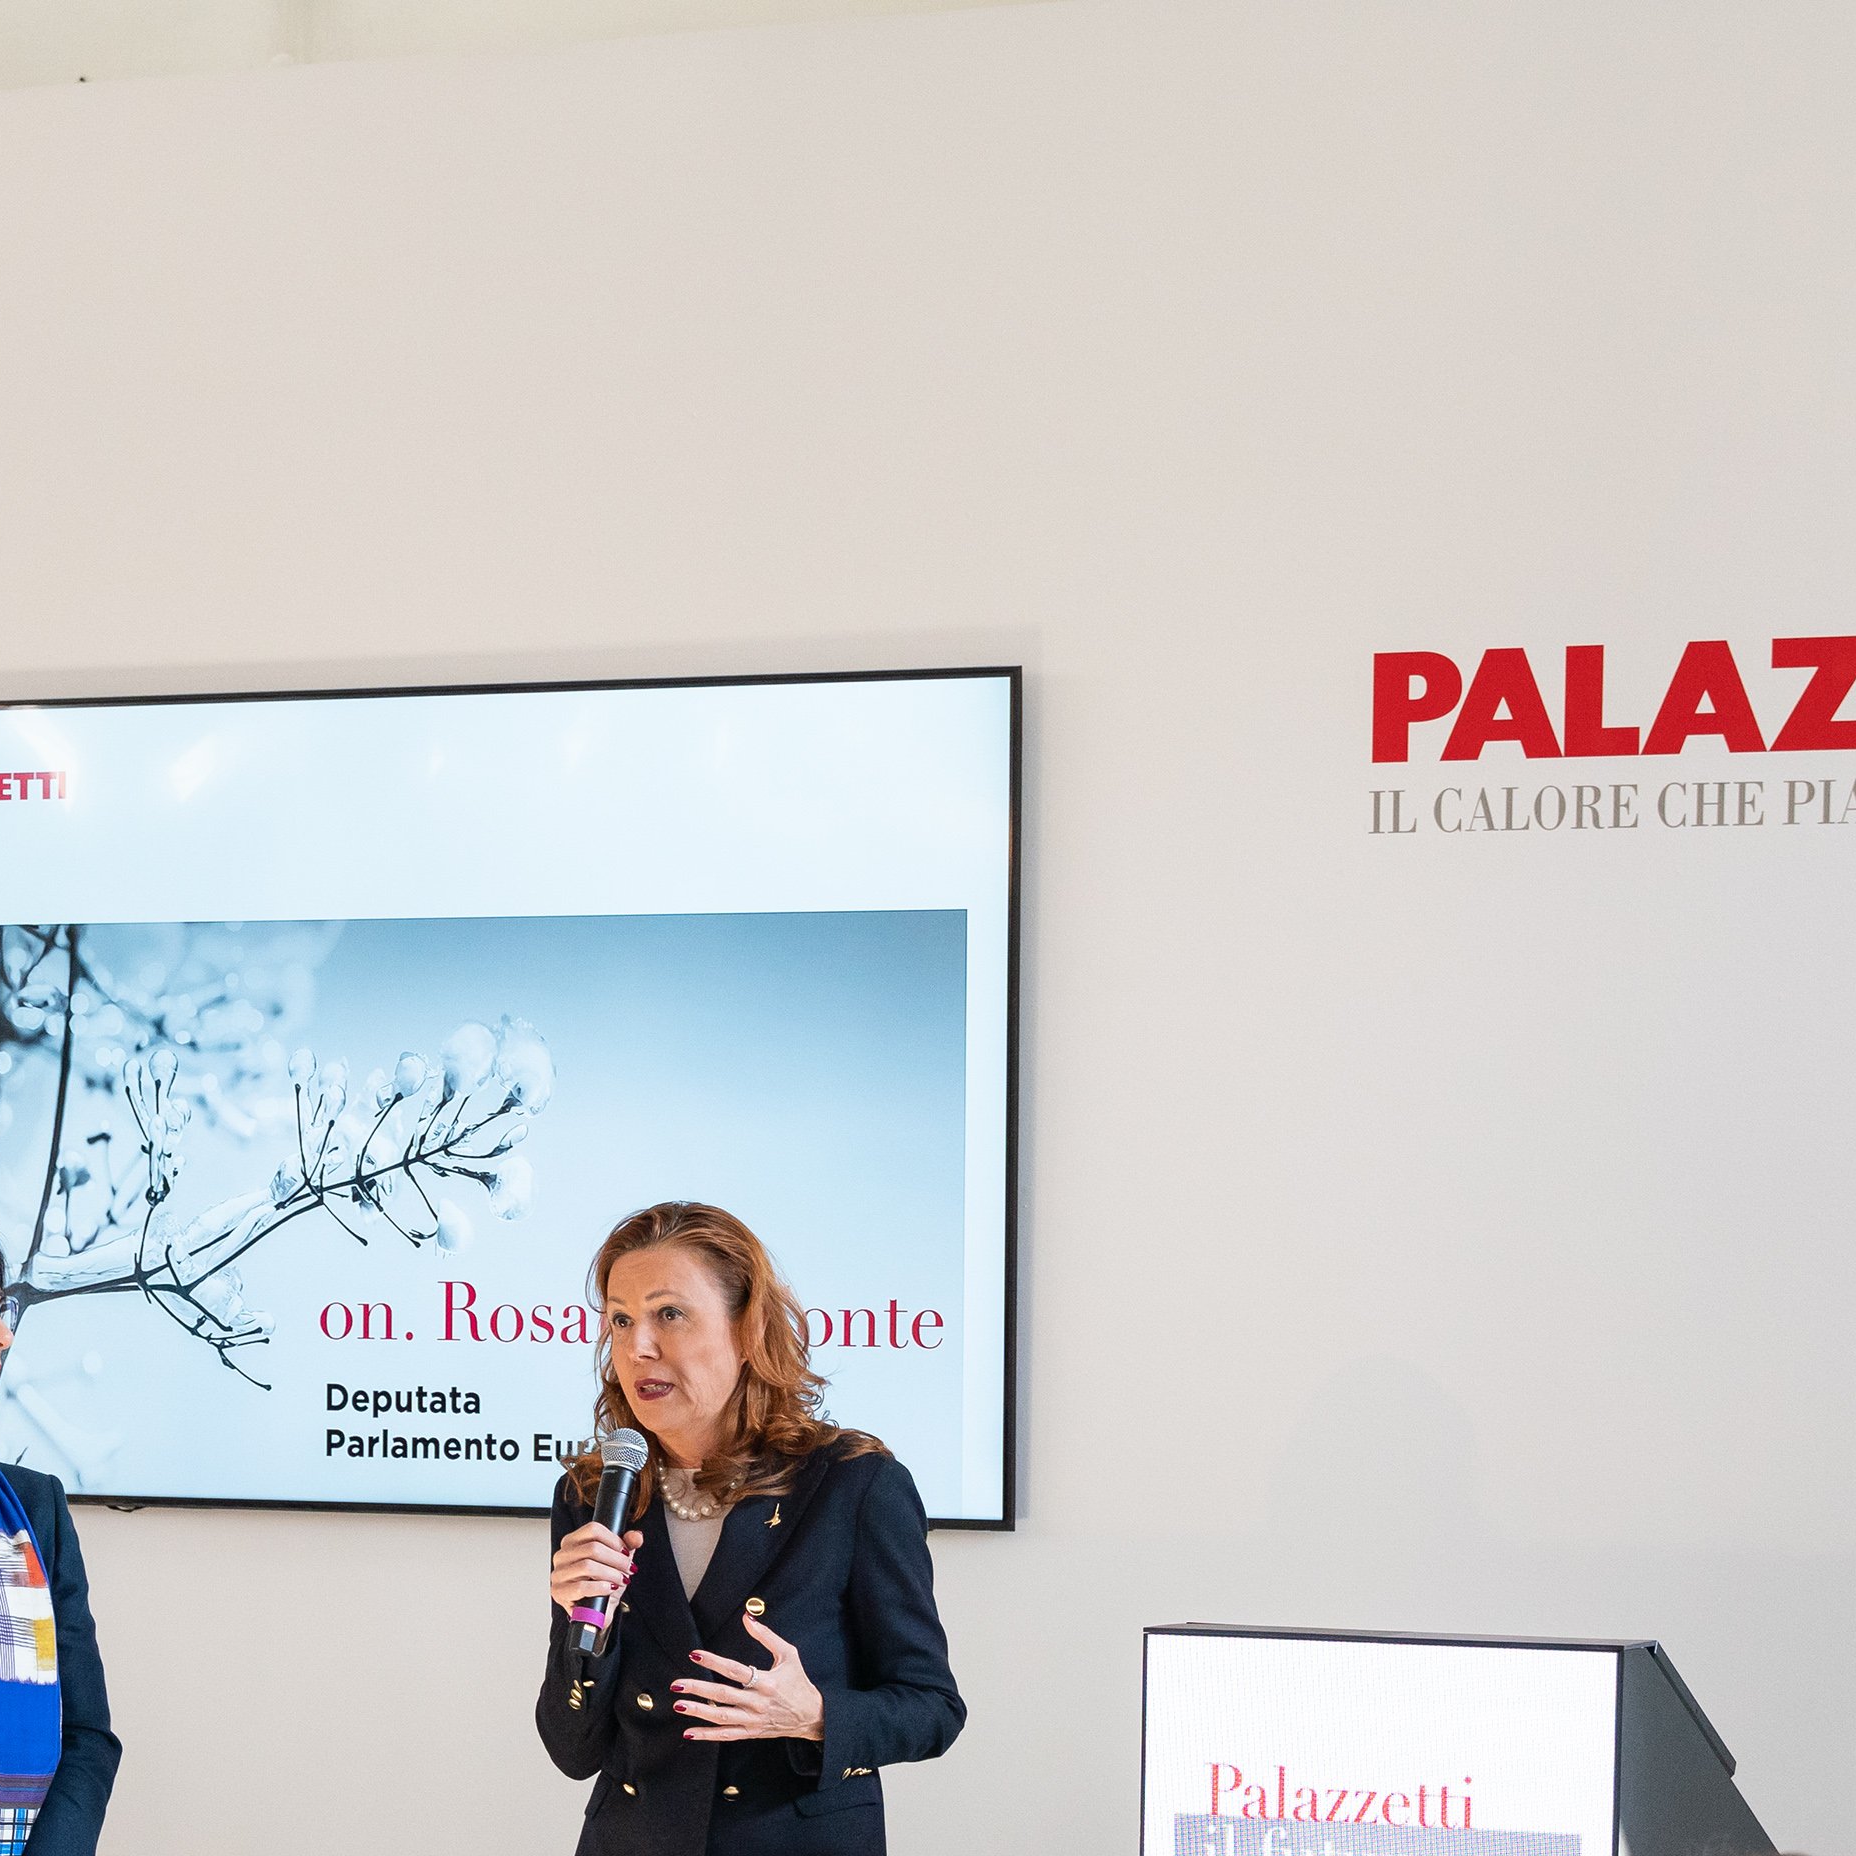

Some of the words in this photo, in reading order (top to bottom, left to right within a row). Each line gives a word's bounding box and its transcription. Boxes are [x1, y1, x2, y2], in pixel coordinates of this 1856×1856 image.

[1367, 787, 1417, 834] IL
[1432, 782, 1640, 833] CALORE
[1657, 780, 1765, 829] CHE
[319, 1299, 414, 1342] on.
[437, 1280, 612, 1344] Rosa
[797, 1299, 944, 1350] onte
[326, 1382, 481, 1417] Deputata
[326, 1429, 520, 1462] Parlamento
[1205, 1762, 1473, 1830] Palazzetti
